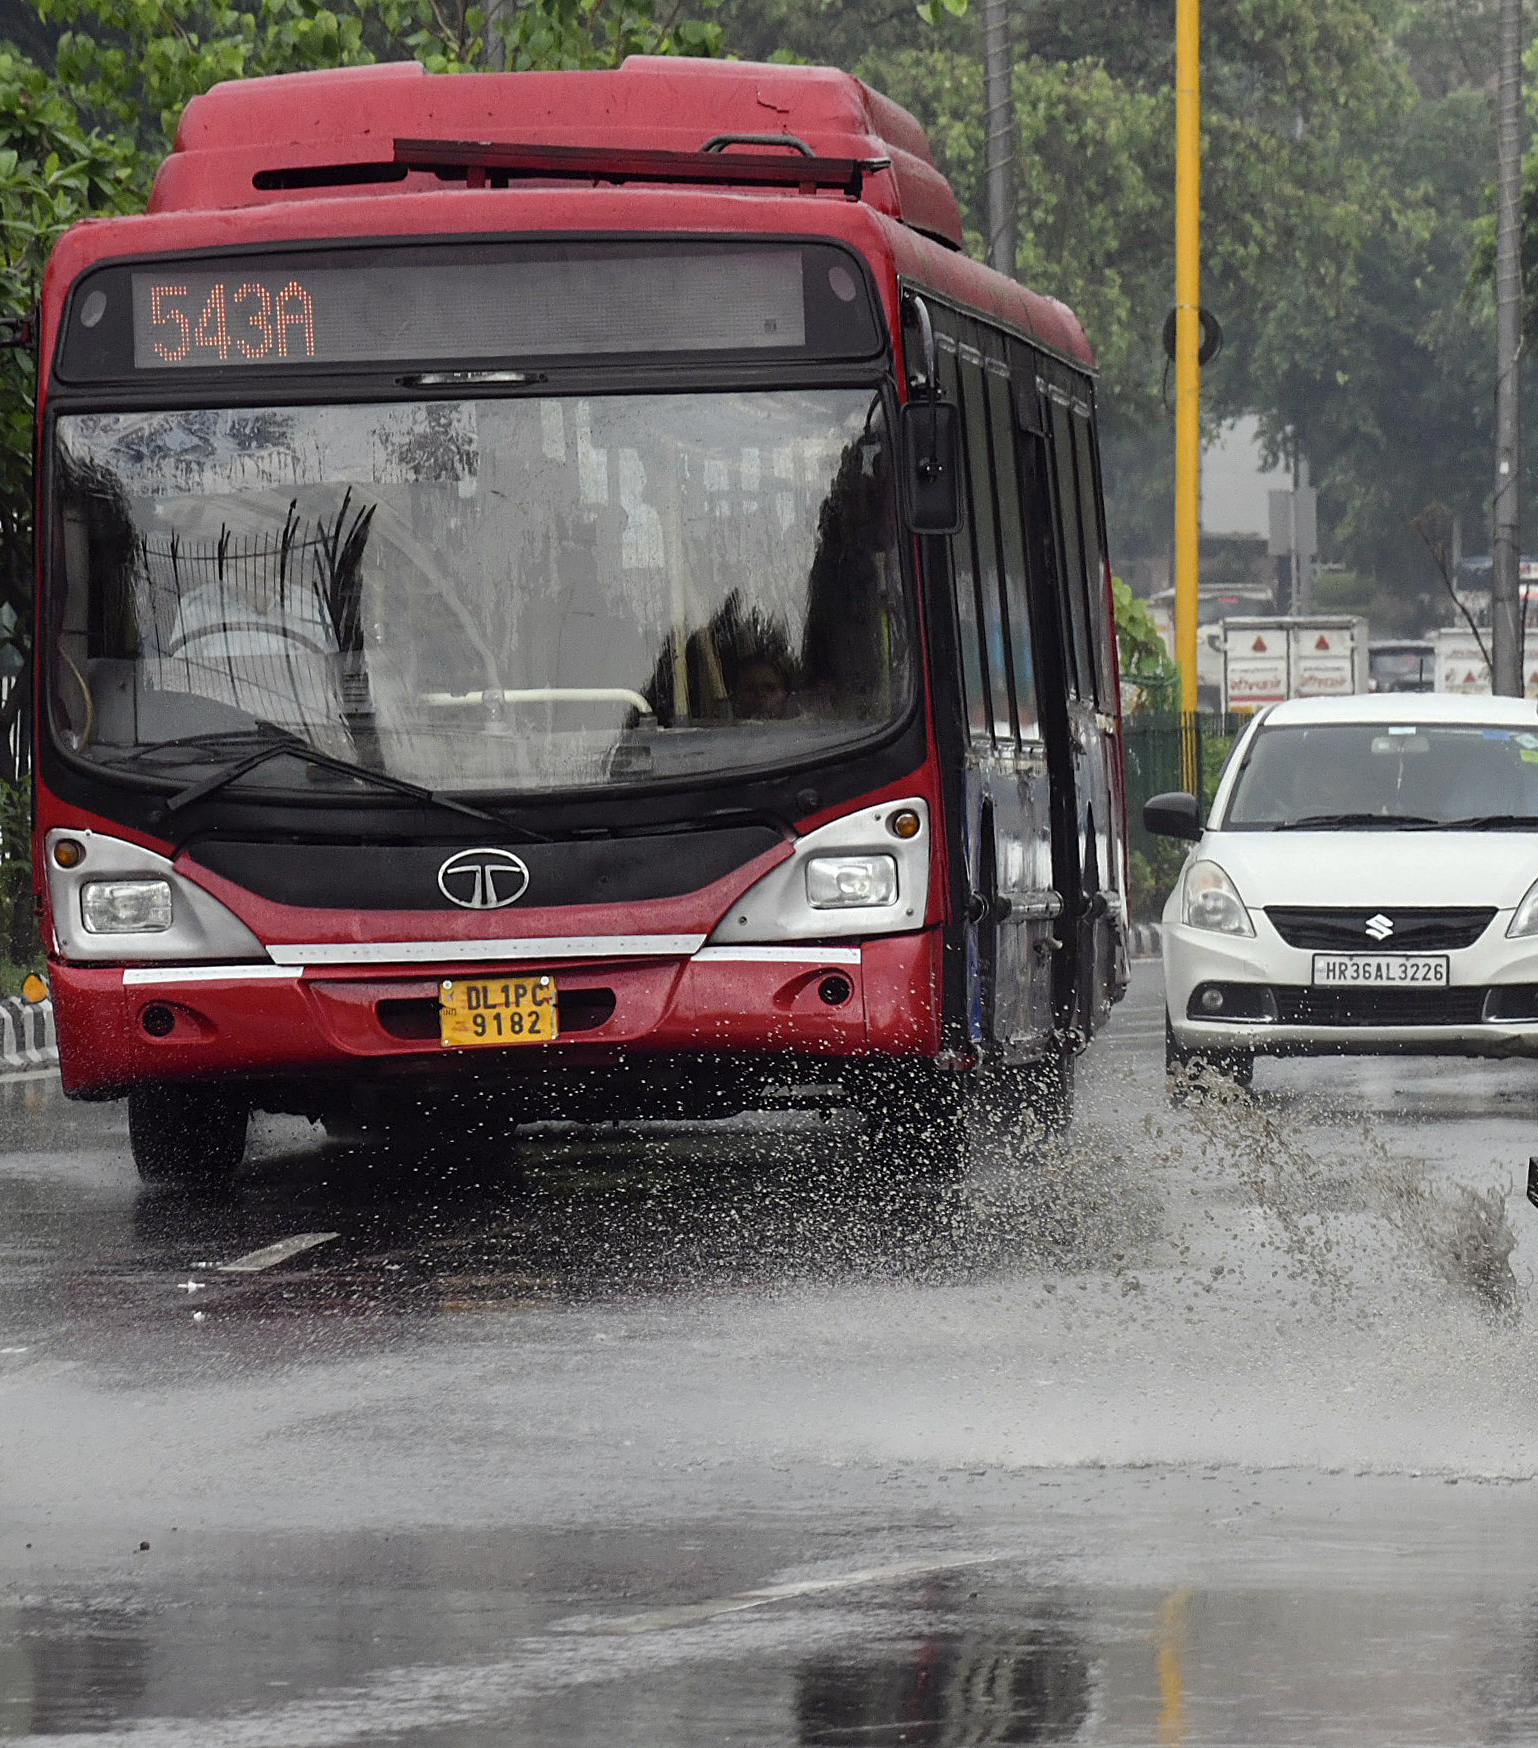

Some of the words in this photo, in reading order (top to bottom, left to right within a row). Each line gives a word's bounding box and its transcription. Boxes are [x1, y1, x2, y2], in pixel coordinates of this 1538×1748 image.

[151, 281, 315, 361] 543A
[1326, 961, 1443, 981] HR36AL3226
[472, 1010, 541, 1037] 9182
